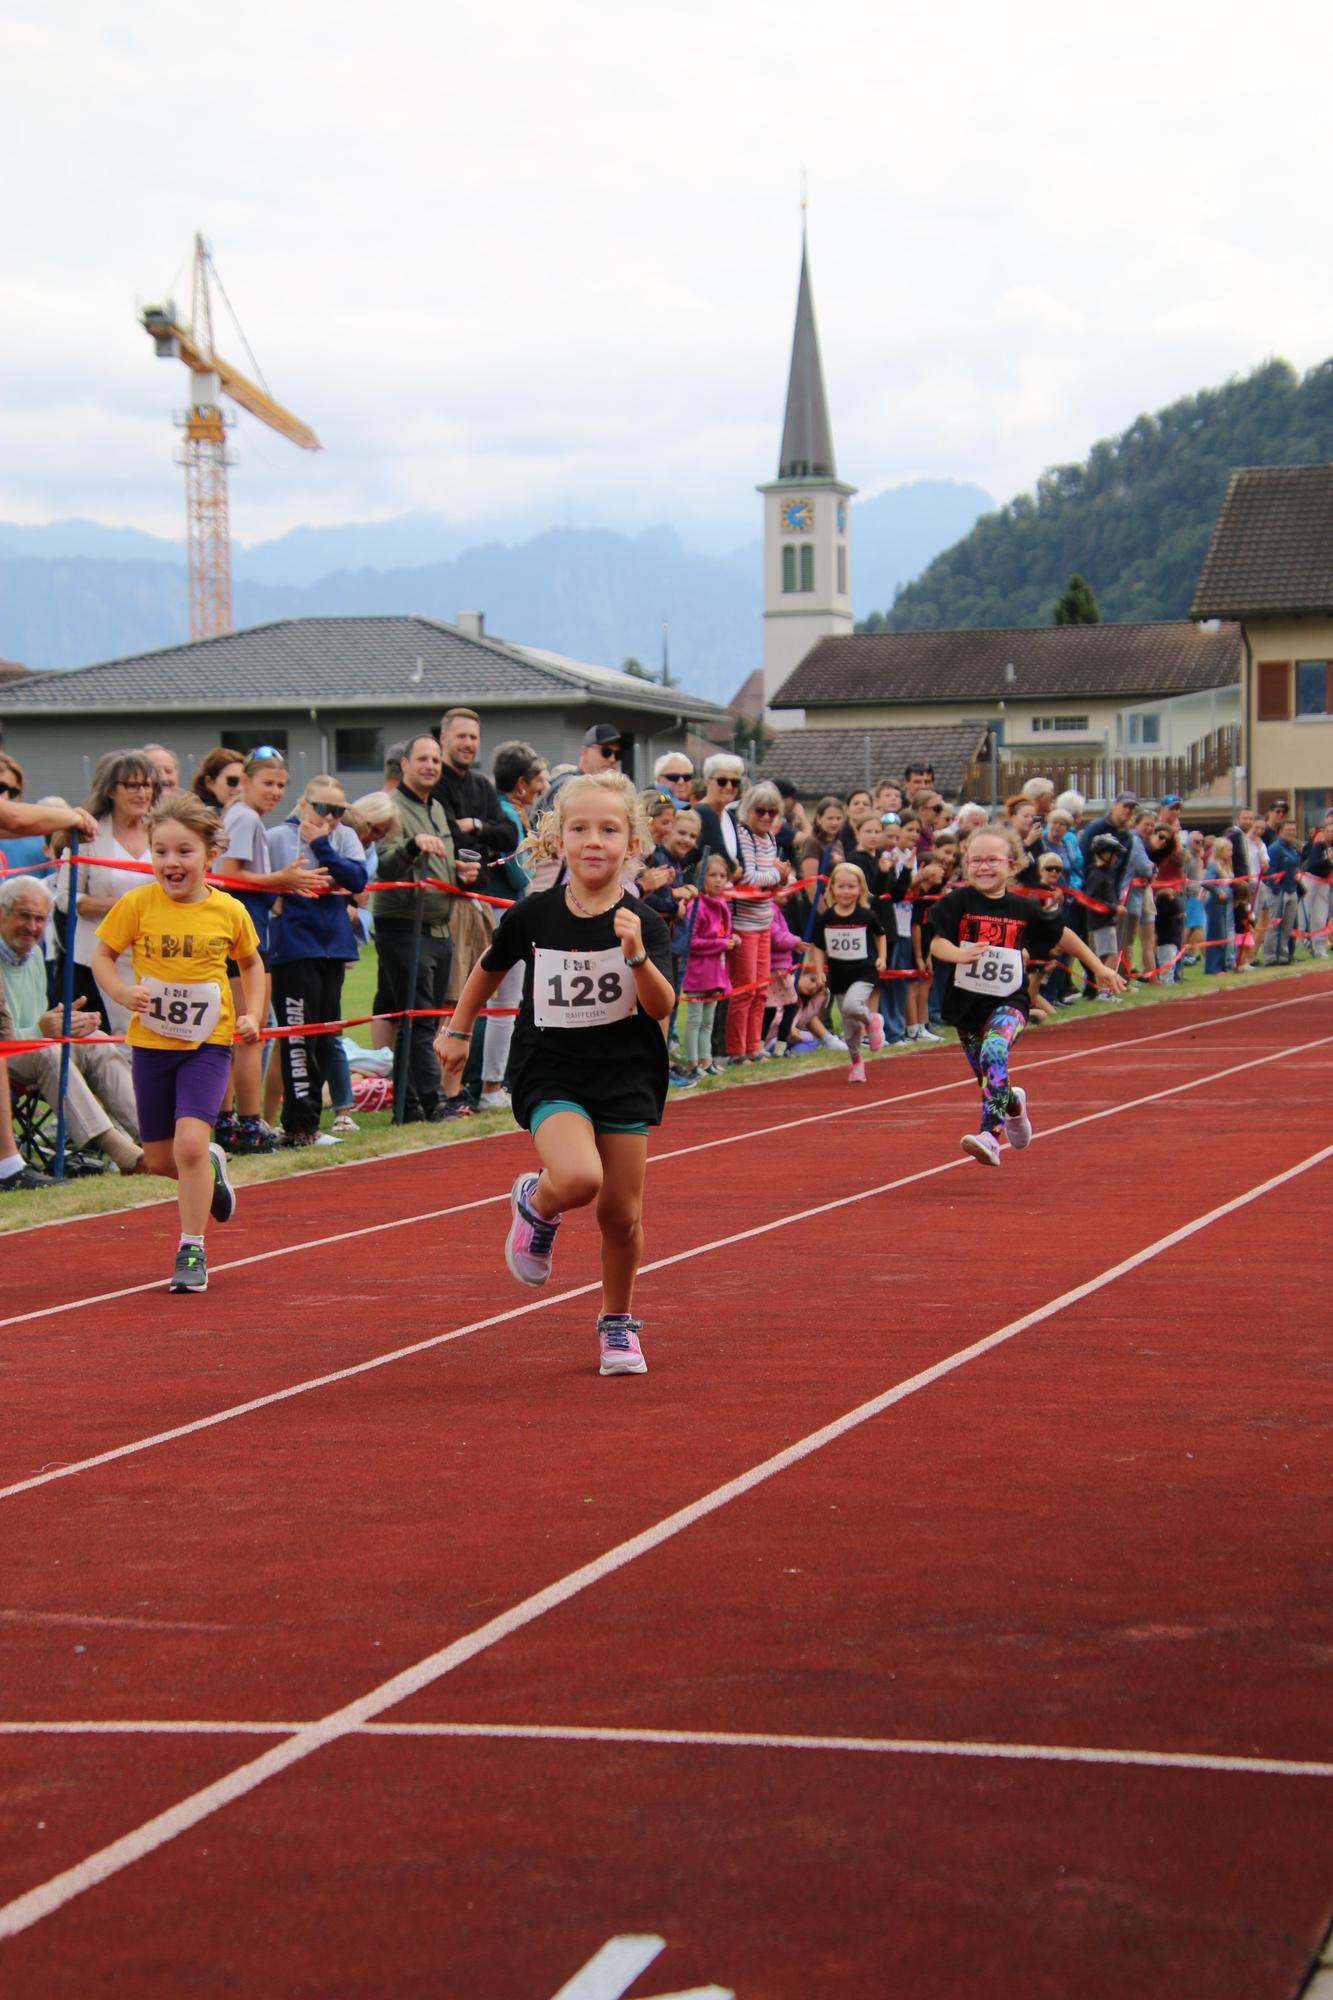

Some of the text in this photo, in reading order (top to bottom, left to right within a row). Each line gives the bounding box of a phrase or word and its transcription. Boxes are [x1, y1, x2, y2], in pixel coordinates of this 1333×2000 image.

[831, 938, 861, 951] 205
[965, 959, 1014, 984] 185
[548, 972, 623, 1007] 128
[149, 997, 209, 1026] 187
[565, 1009, 606, 1019] RAIFFEISEN
[286, 997, 310, 1099] TV BAD RGAZ
